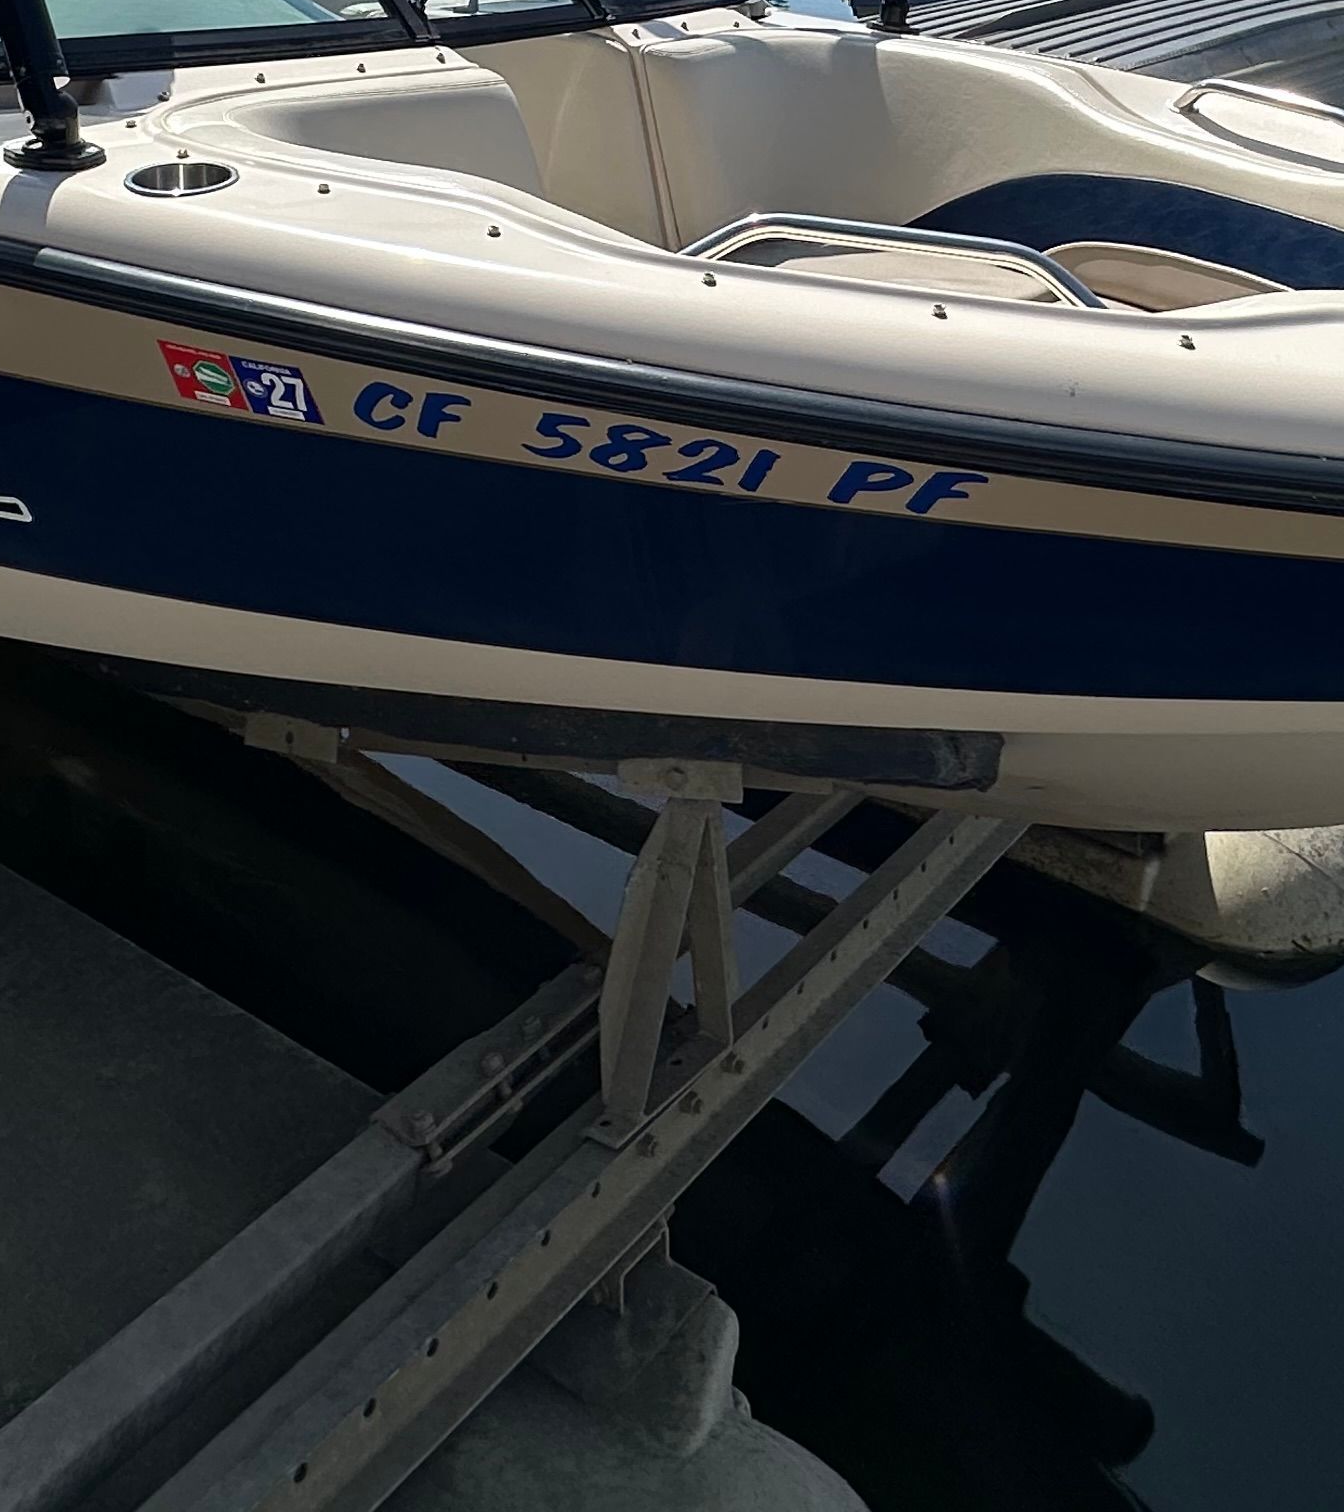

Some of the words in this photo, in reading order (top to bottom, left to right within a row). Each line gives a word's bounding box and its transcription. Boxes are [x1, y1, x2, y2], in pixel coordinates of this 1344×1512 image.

[261, 372, 308, 412] 27
[353, 381, 473, 439] CF
[521, 411, 781, 493] 5821
[827, 460, 990, 515] PF
